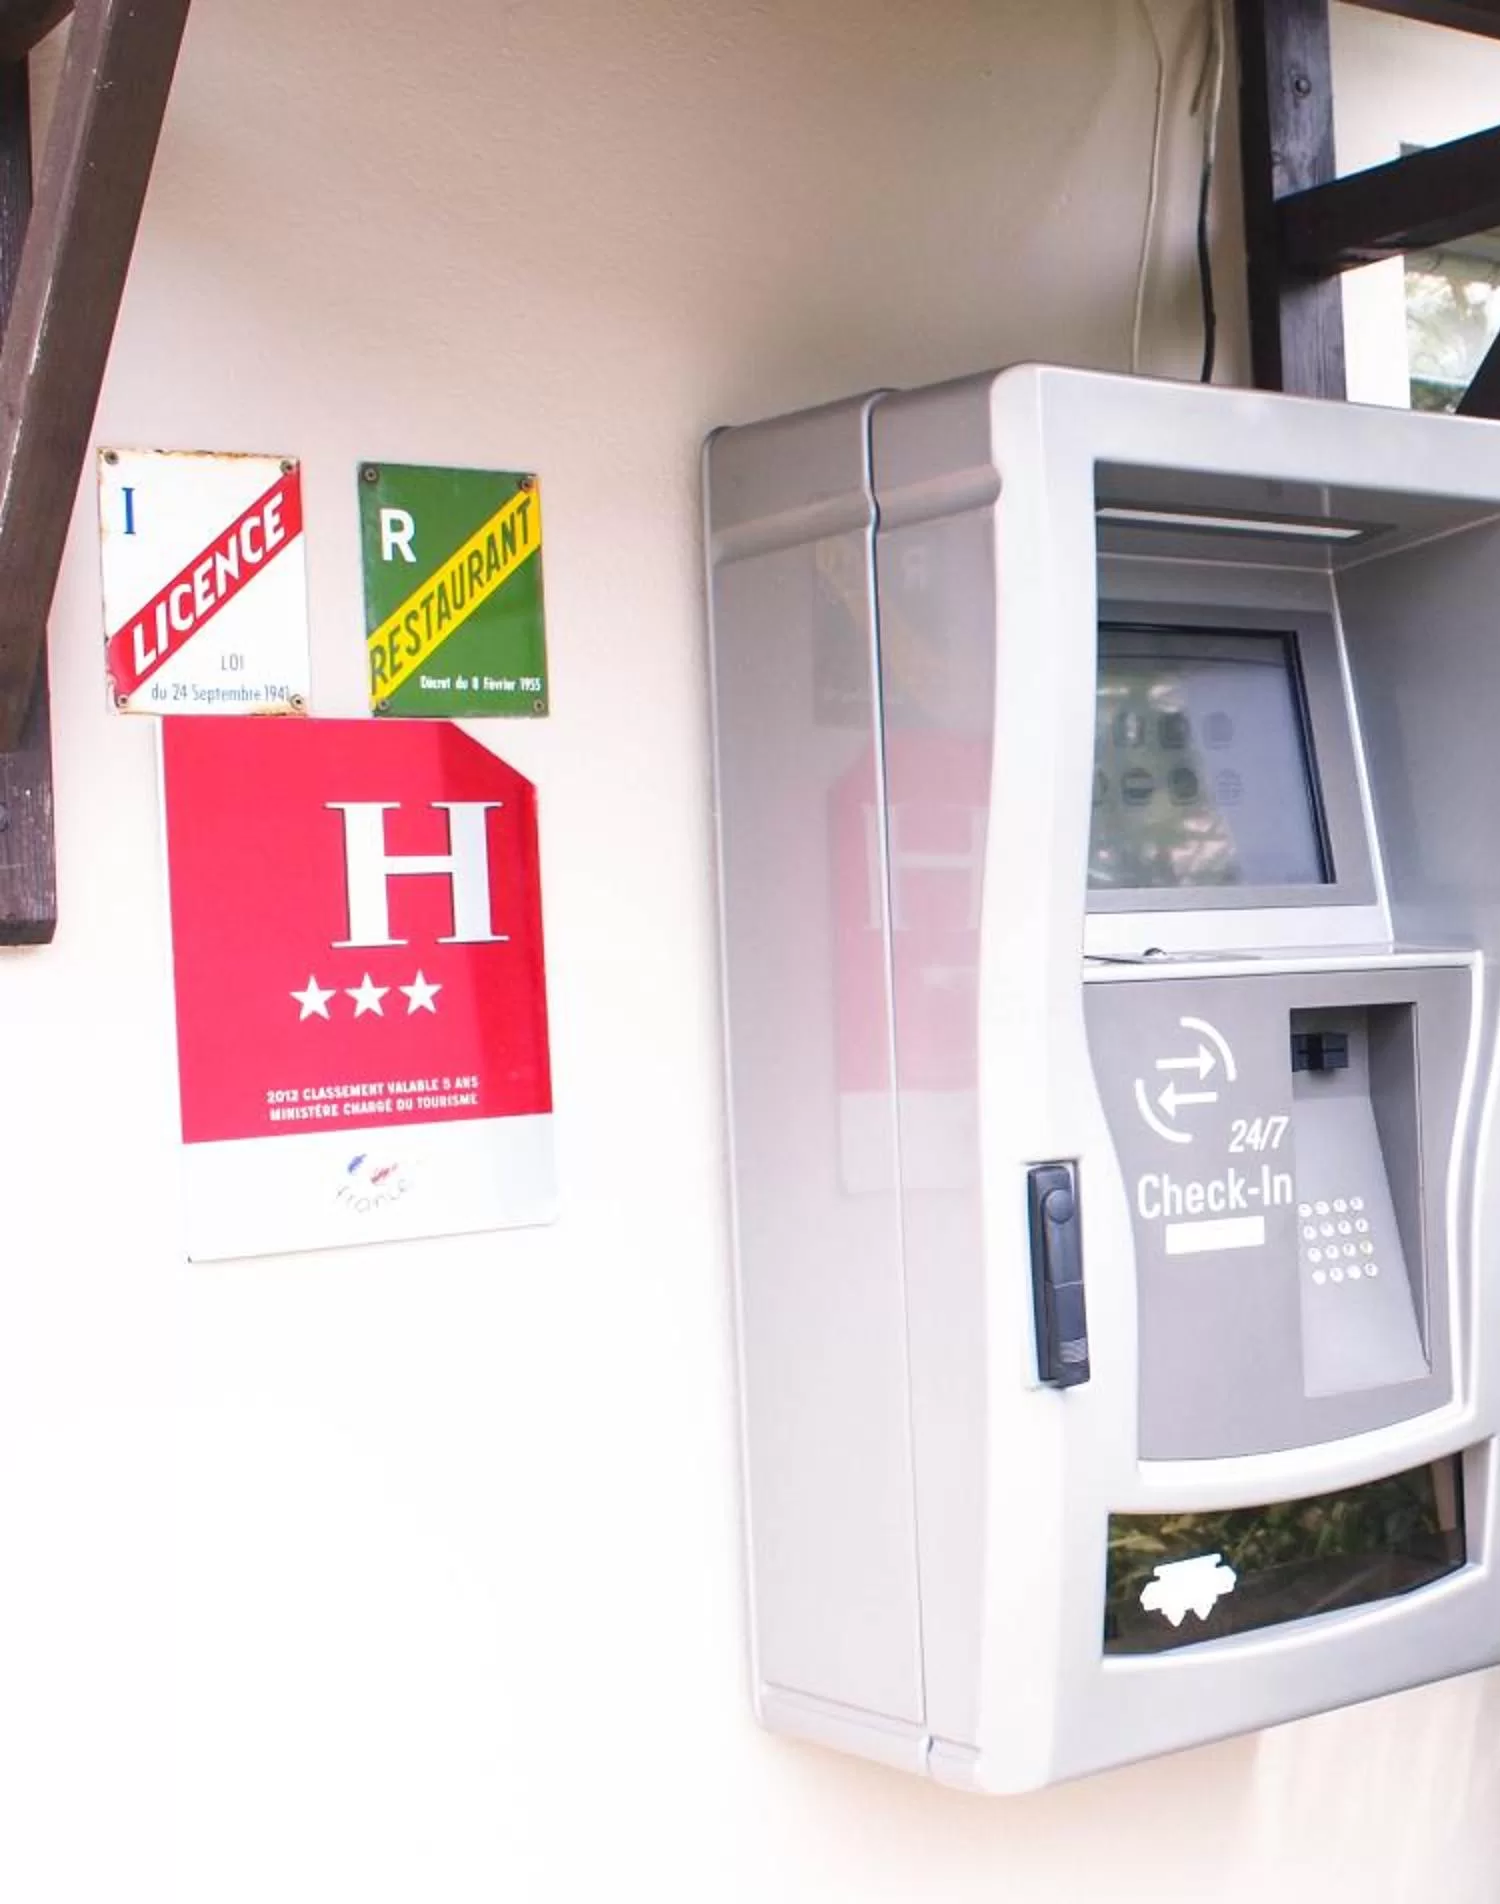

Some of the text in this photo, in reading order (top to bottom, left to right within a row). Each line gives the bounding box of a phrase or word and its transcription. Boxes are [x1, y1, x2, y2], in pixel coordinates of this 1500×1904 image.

[380, 507, 417, 563] R
[132, 491, 286, 677] LICENCE
[369, 496, 532, 697] RESTAURANT
[221, 654, 245, 672] LOI
[151, 683, 168, 701] du
[171, 684, 188, 701] 24
[191, 684, 262, 704] Septembre
[455, 673, 469, 690] du
[483, 676, 516, 692] Février
[520, 676, 541, 692] 1955
[324, 801, 510, 949] H
[266, 1075, 479, 1104] 2012 CLASSEMENT VALABLE 5 ANS
[396, 1097, 413, 1112] DU
[416, 1091, 478, 1109] TOURISME
[1227, 1115, 1291, 1153] 24/7
[1136, 1163, 1294, 1219] Check-In
